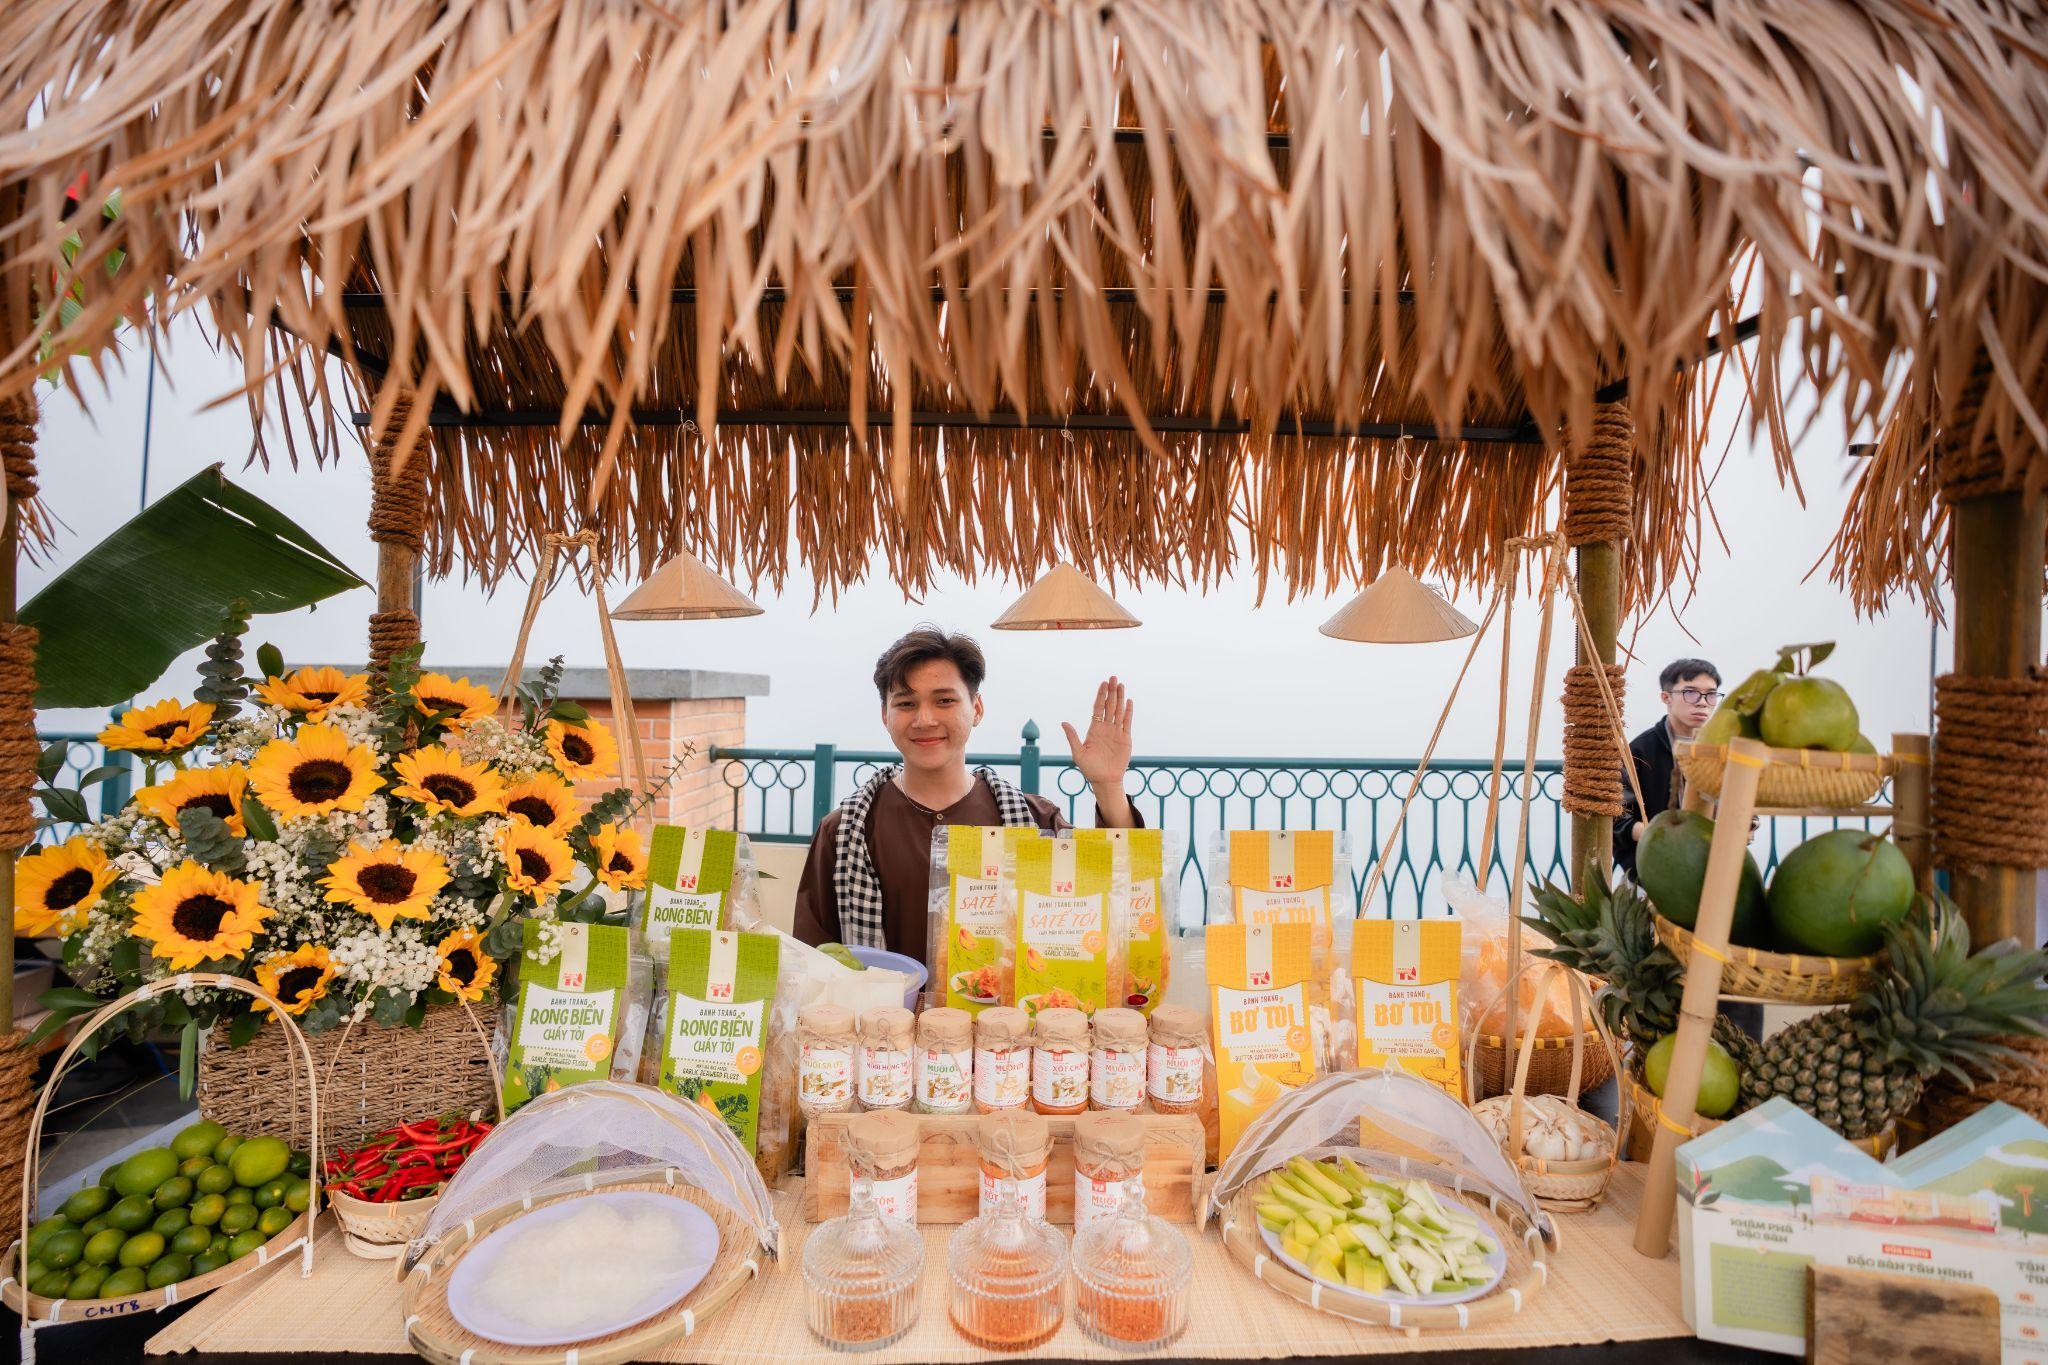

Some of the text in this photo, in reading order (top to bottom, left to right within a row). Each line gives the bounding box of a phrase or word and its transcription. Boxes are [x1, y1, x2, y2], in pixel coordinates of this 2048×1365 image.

[654, 902, 713, 925] RONG BIỂN
[530, 1001, 604, 1026] RONG BIỂN
[680, 1012, 753, 1037] RONG BIỂN
[1230, 1006, 1260, 1034] BƠ
[1374, 1001, 1406, 1027] BƠ
[543, 1025, 568, 1040] CHÁY
[693, 1037, 718, 1052] CHÁY
[85, 1300, 140, 1318] CMT8
